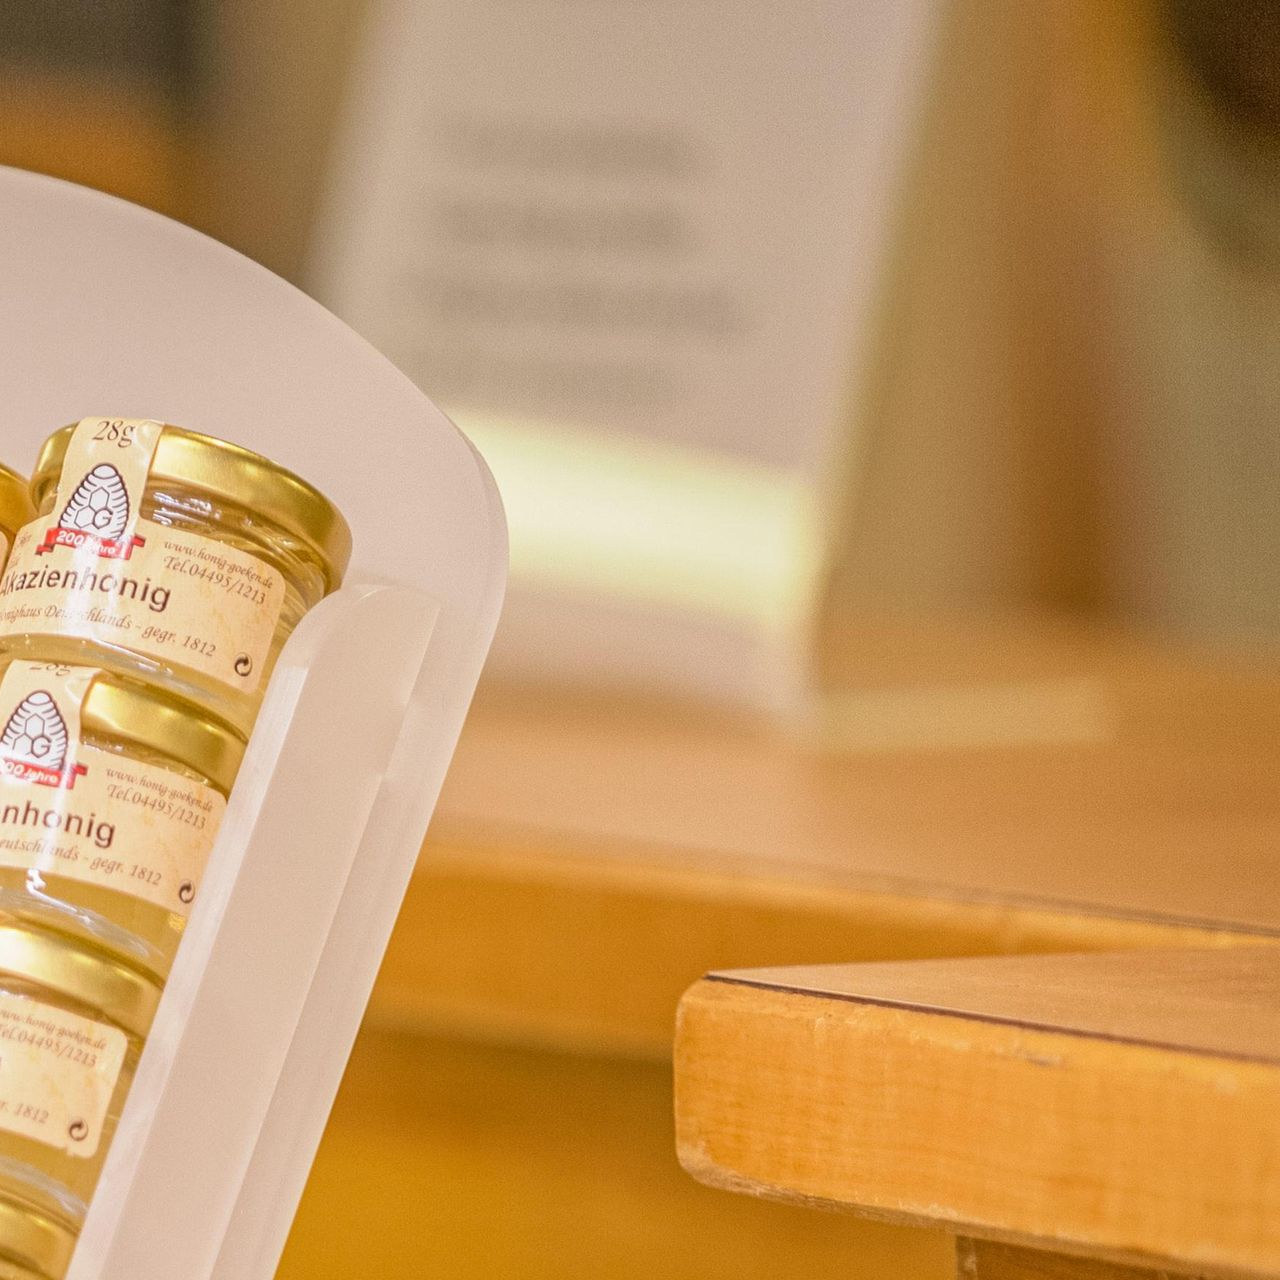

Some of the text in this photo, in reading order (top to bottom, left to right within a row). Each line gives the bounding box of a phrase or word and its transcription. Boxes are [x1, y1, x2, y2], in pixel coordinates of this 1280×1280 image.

[92, 420, 135, 448] 28g
[57, 531, 84, 545] 200
[163, 555, 266, 604] Tel.04495/1213
[142, 624, 217, 658] gegr. 1812
[107, 784, 207, 830] Tel.04495/1213
[90, 855, 163, 886] gegr. 1812
[16, 1102, 49, 1124] 1812
